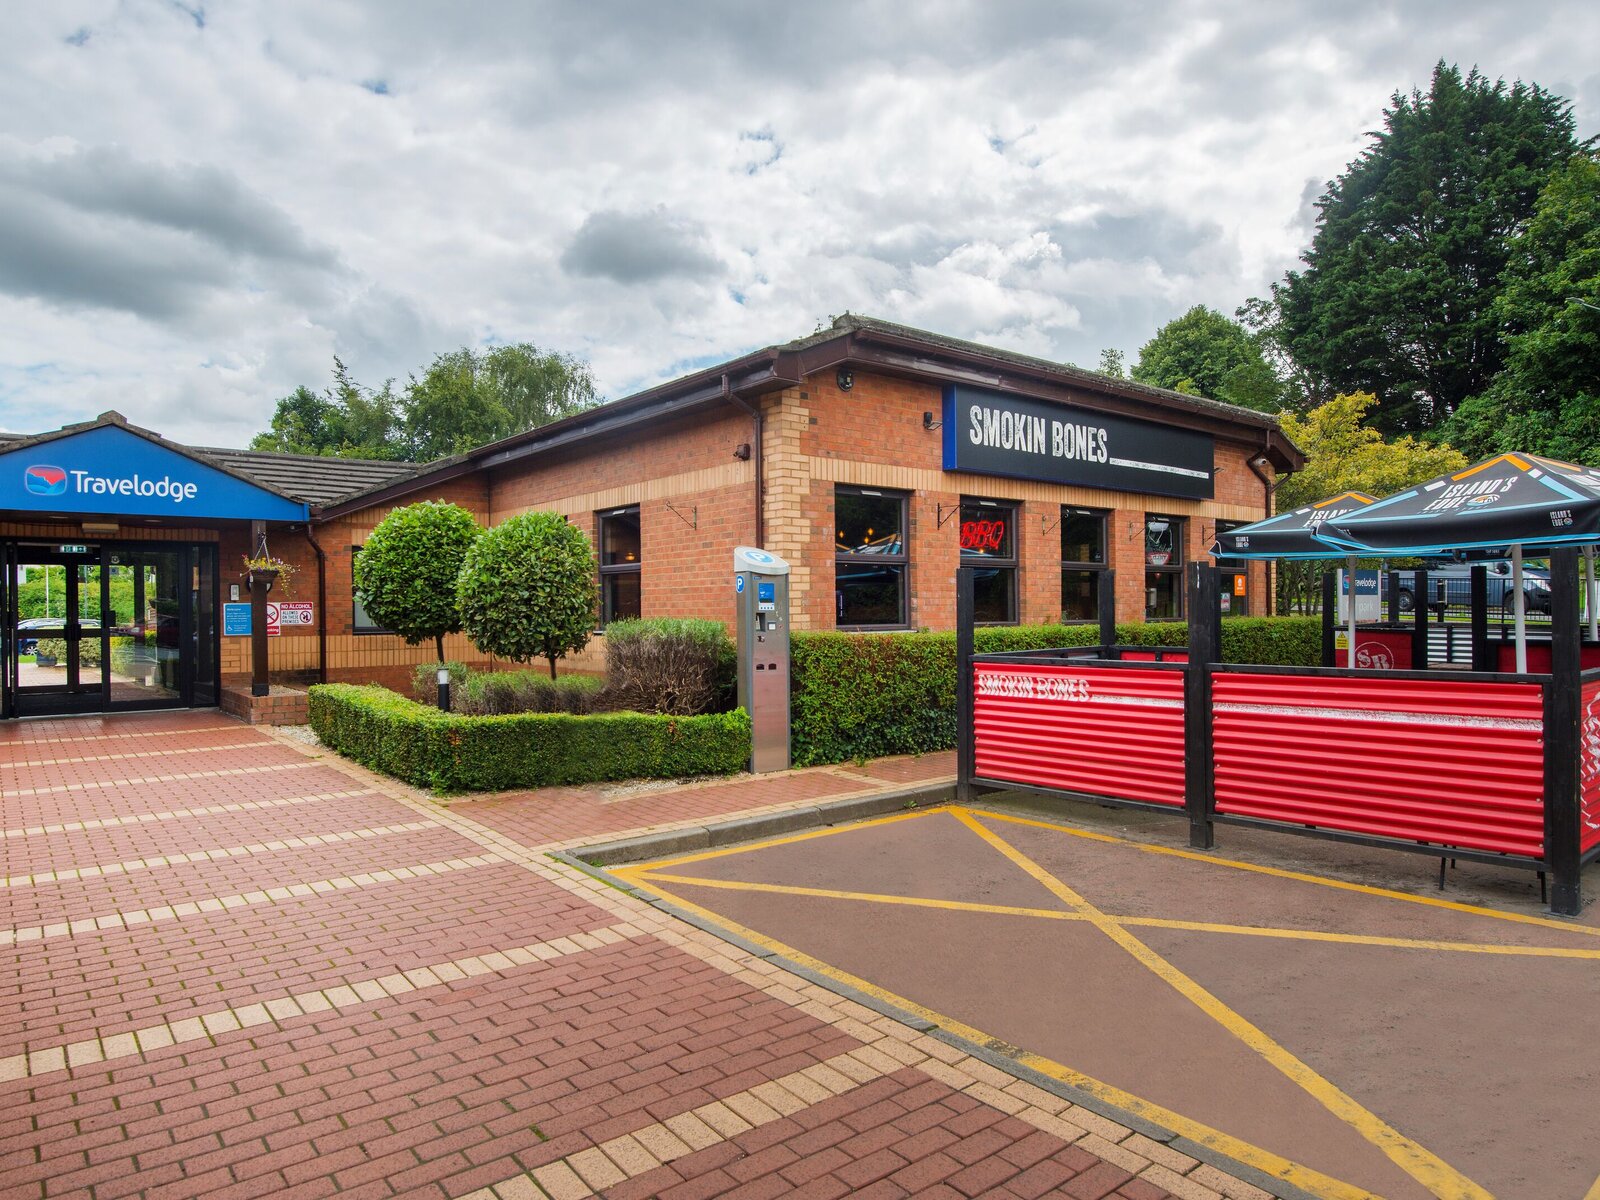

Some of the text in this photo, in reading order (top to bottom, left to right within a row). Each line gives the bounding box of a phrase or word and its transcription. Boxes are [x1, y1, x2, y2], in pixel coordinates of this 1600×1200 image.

[969, 405, 1108, 464] SMOKIN BONES
[70, 470, 198, 502] Travelodge
[1439, 476, 1518, 498] ISLAND'S
[1423, 496, 1471, 511] EDGE
[960, 520, 1005, 551] BBQ
[737, 578, 742, 590] P
[1355, 577, 1377, 589] ravelodge
[978, 673, 1090, 702] SMOKIN BONES
